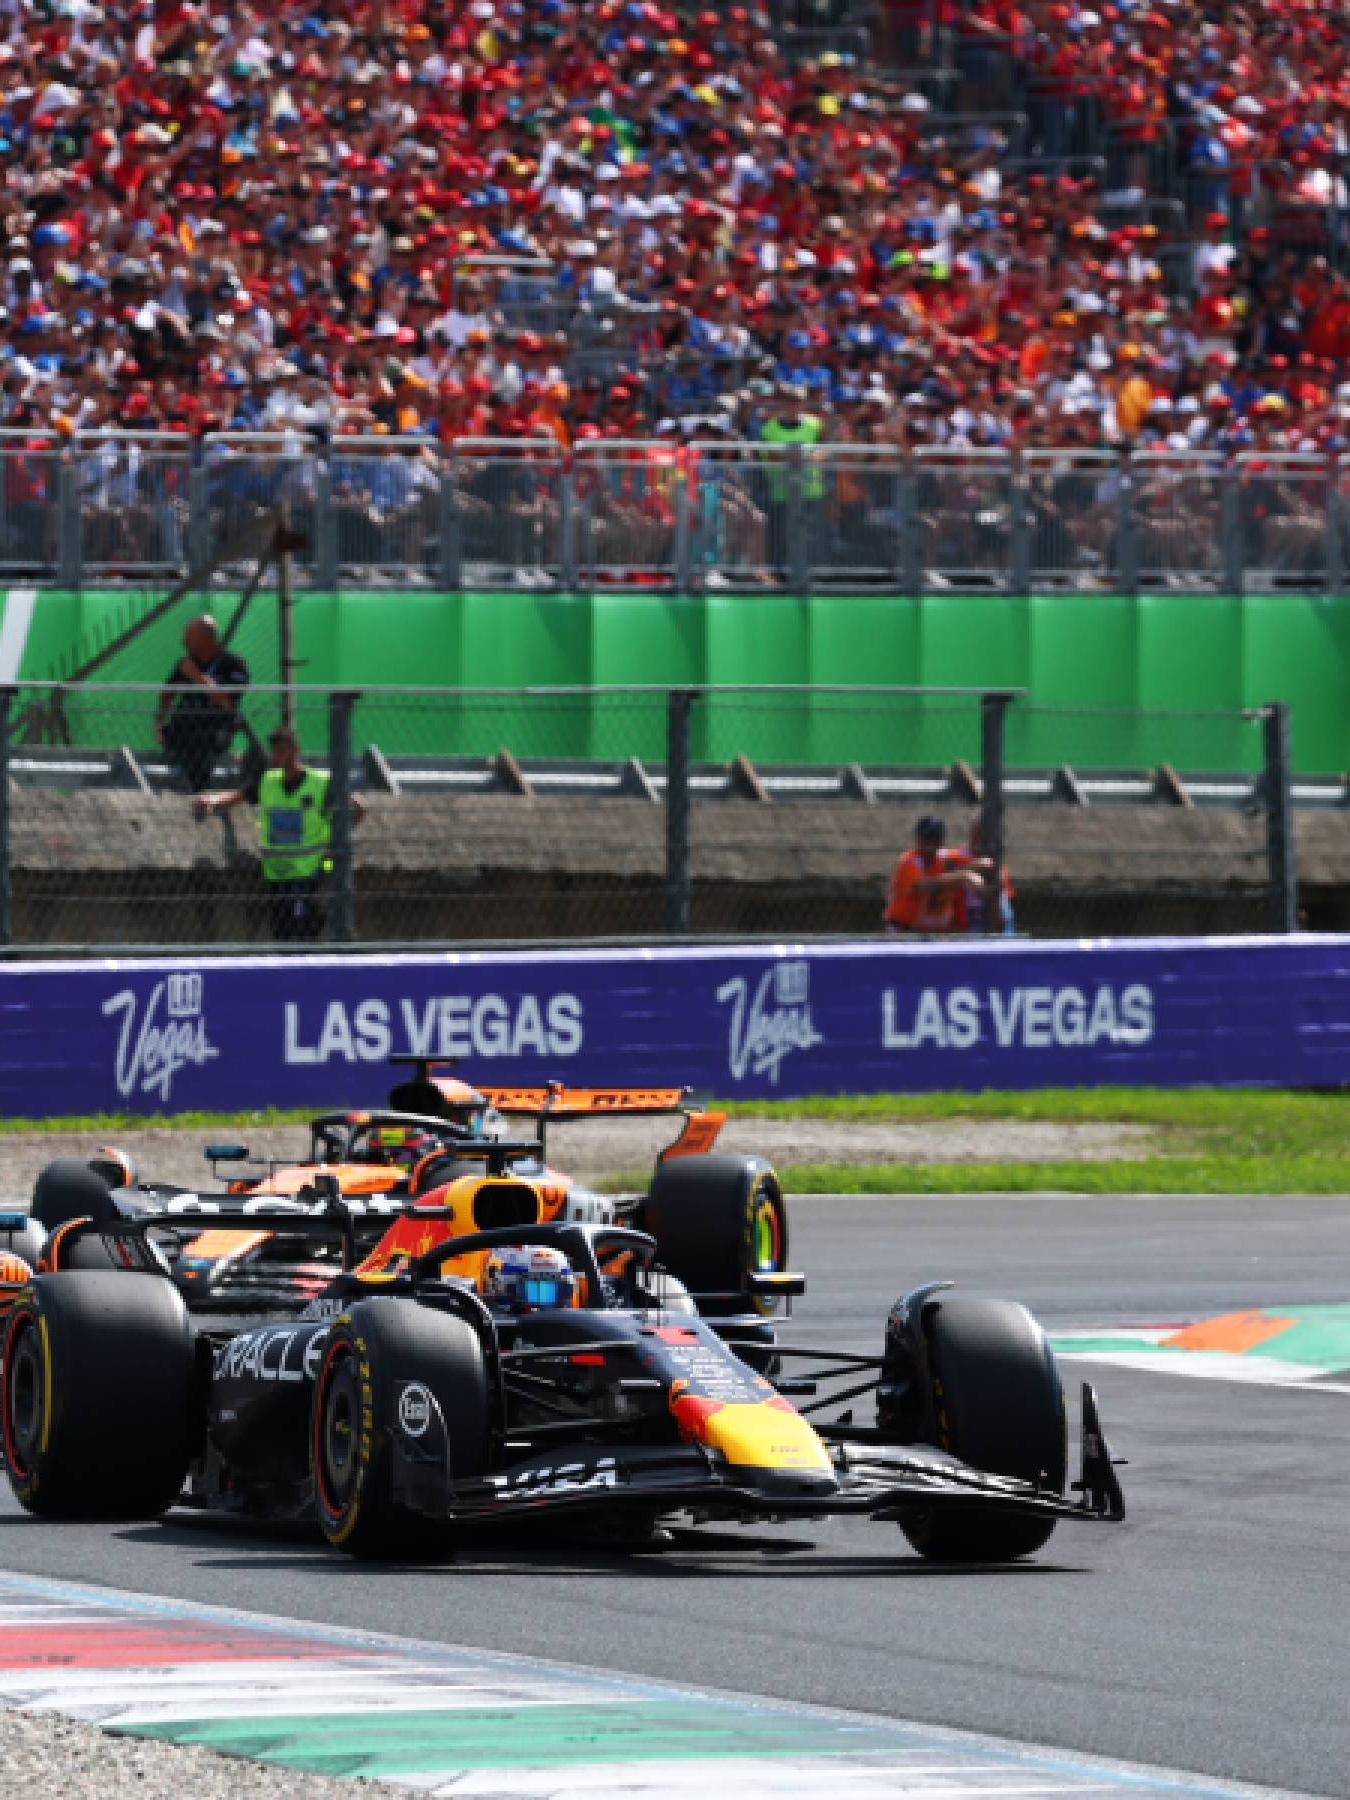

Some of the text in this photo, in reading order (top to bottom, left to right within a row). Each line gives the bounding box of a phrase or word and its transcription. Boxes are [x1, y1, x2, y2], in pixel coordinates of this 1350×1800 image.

[103, 981, 219, 1101] Vegas
[285, 994, 583, 1065] LAS VEGAS
[882, 984, 1154, 1048] LAS VEGAS
